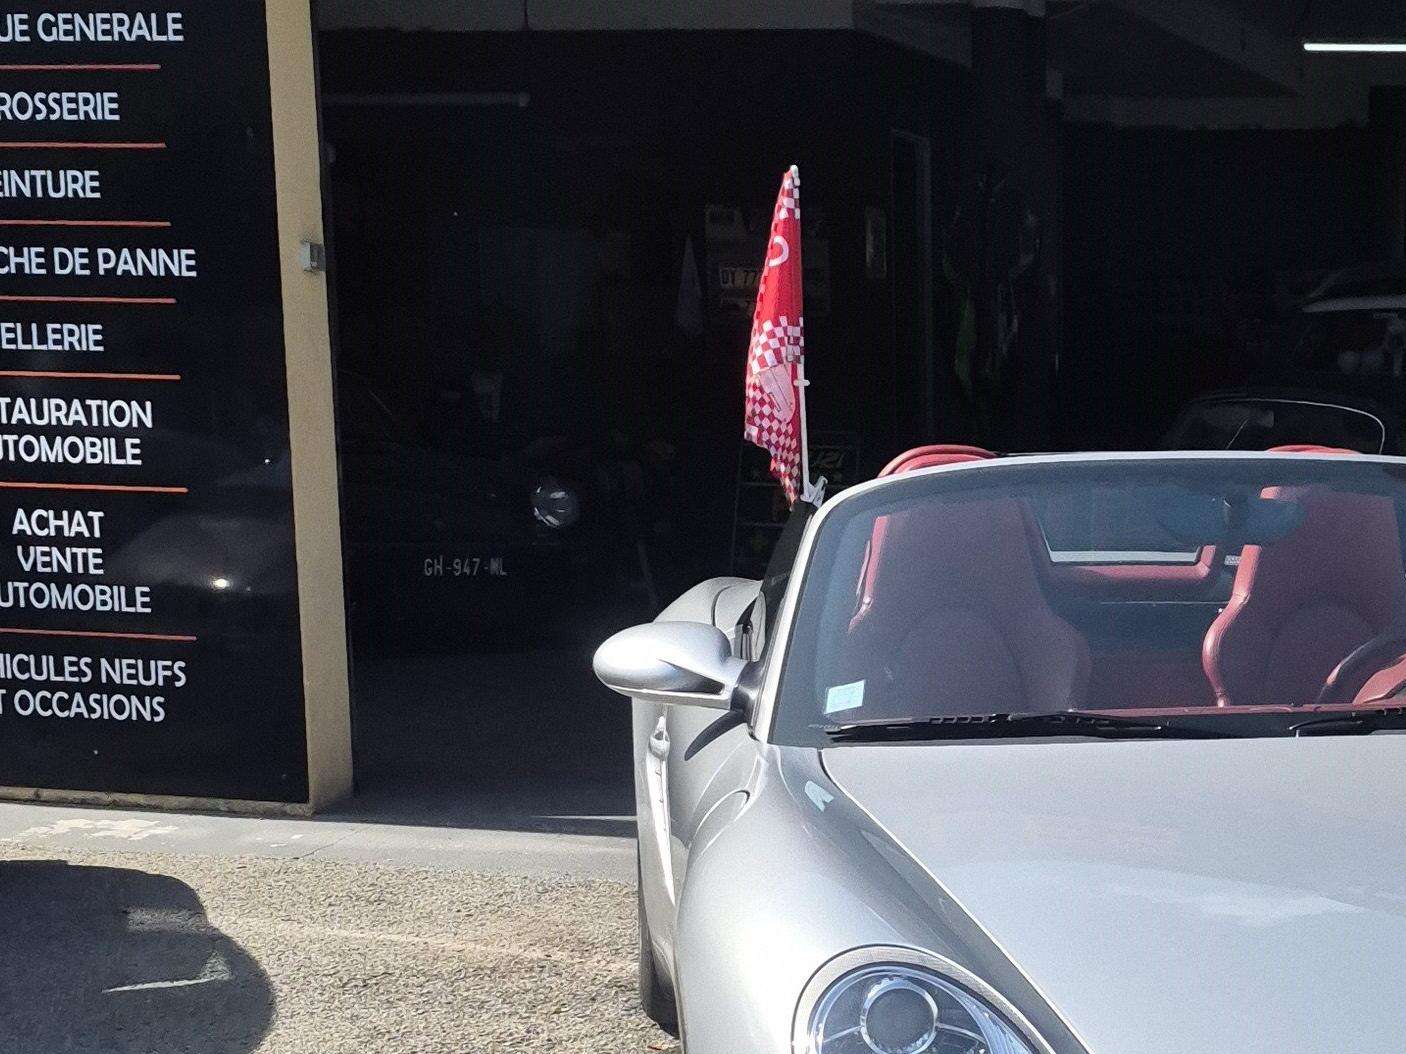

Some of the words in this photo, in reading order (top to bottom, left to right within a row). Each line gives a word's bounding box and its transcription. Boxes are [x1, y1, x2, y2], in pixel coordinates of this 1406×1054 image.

[36, 12, 185, 42] GENERALE
[0, 91, 121, 121] ROSSERIE
[0, 169, 102, 199] INTURE
[53, 246, 91, 276] DE
[97, 247, 197, 278] PANNE
[0, 322, 105, 352] ELLERIE
[0, 434, 143, 466] TOMOBILE
[11, 508, 105, 539] ACHAT
[16, 545, 105, 575] VENTE
[0, 653, 93, 683] ICULES
[99, 658, 187, 688] NEUFS
[13, 689, 166, 723] OCCASIONS
